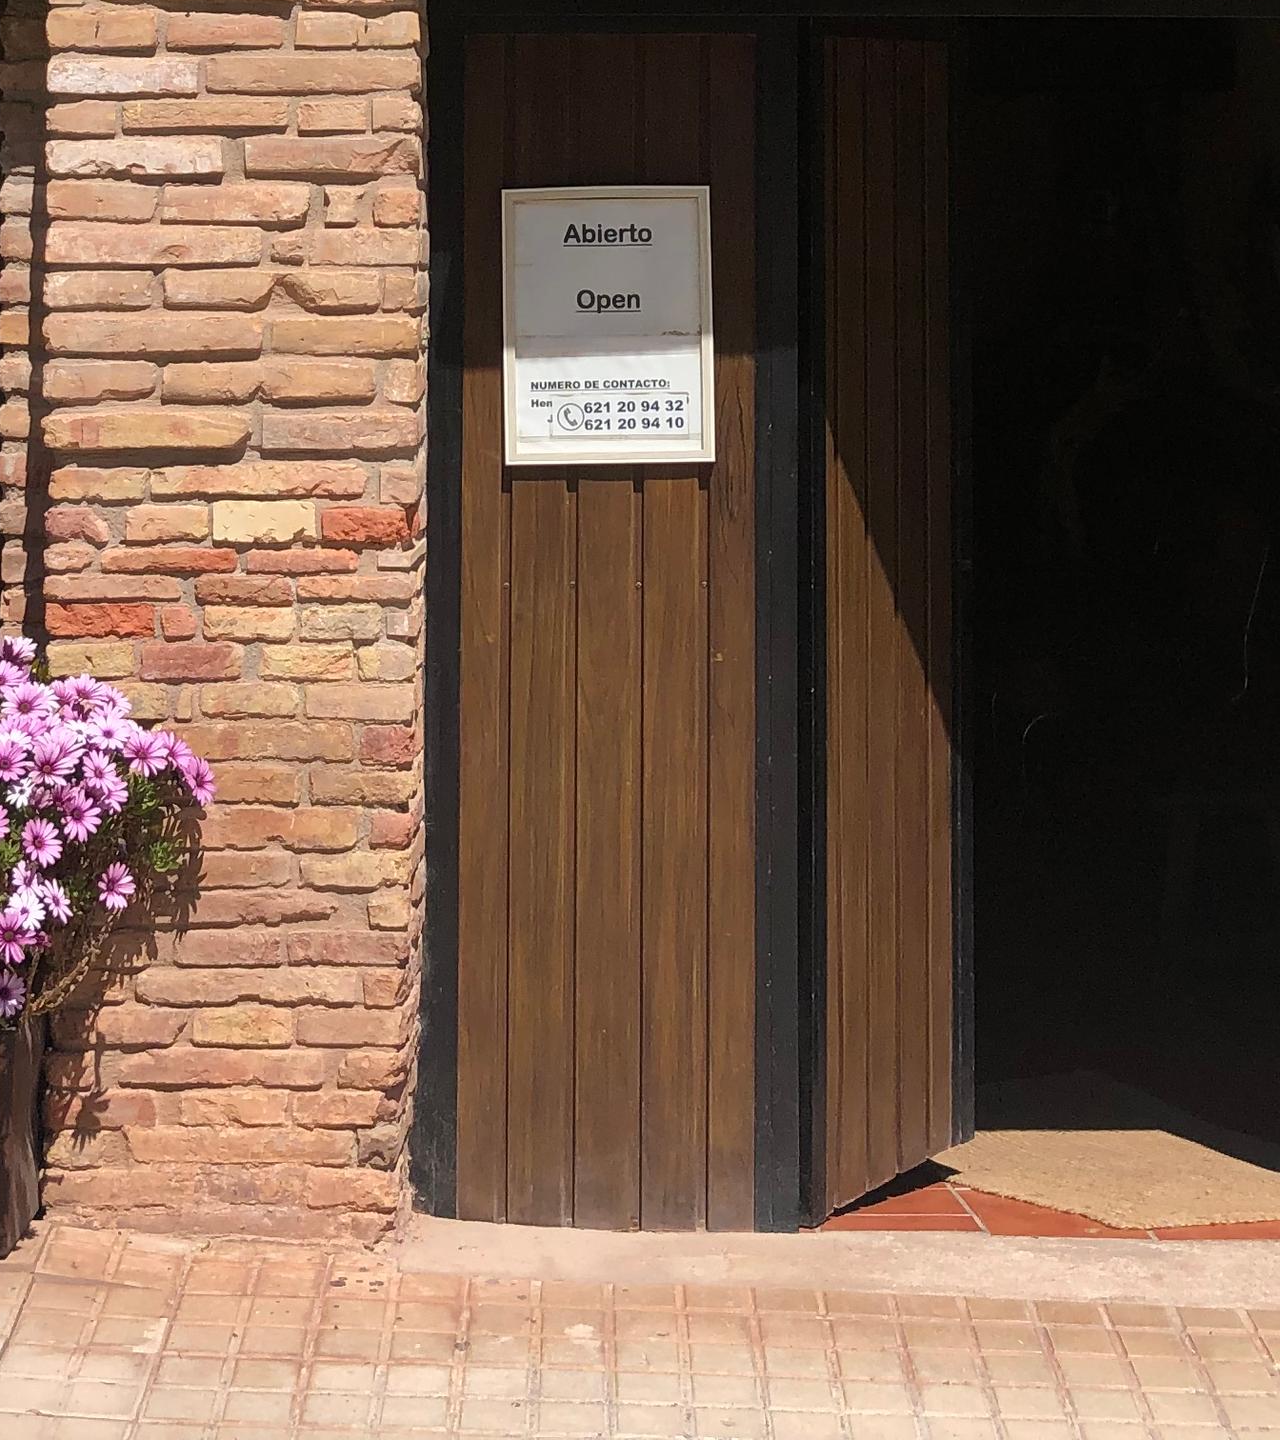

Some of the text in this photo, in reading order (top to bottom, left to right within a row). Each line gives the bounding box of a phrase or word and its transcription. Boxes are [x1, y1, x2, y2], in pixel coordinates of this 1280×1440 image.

[563, 223, 653, 244] Abierto
[576, 289, 641, 314] Open
[531, 378, 670, 390] NUMERO DE CONTACTO:
[584, 399, 684, 414] 621 20 94 32
[584, 417, 684, 430] 621 20 94 10
